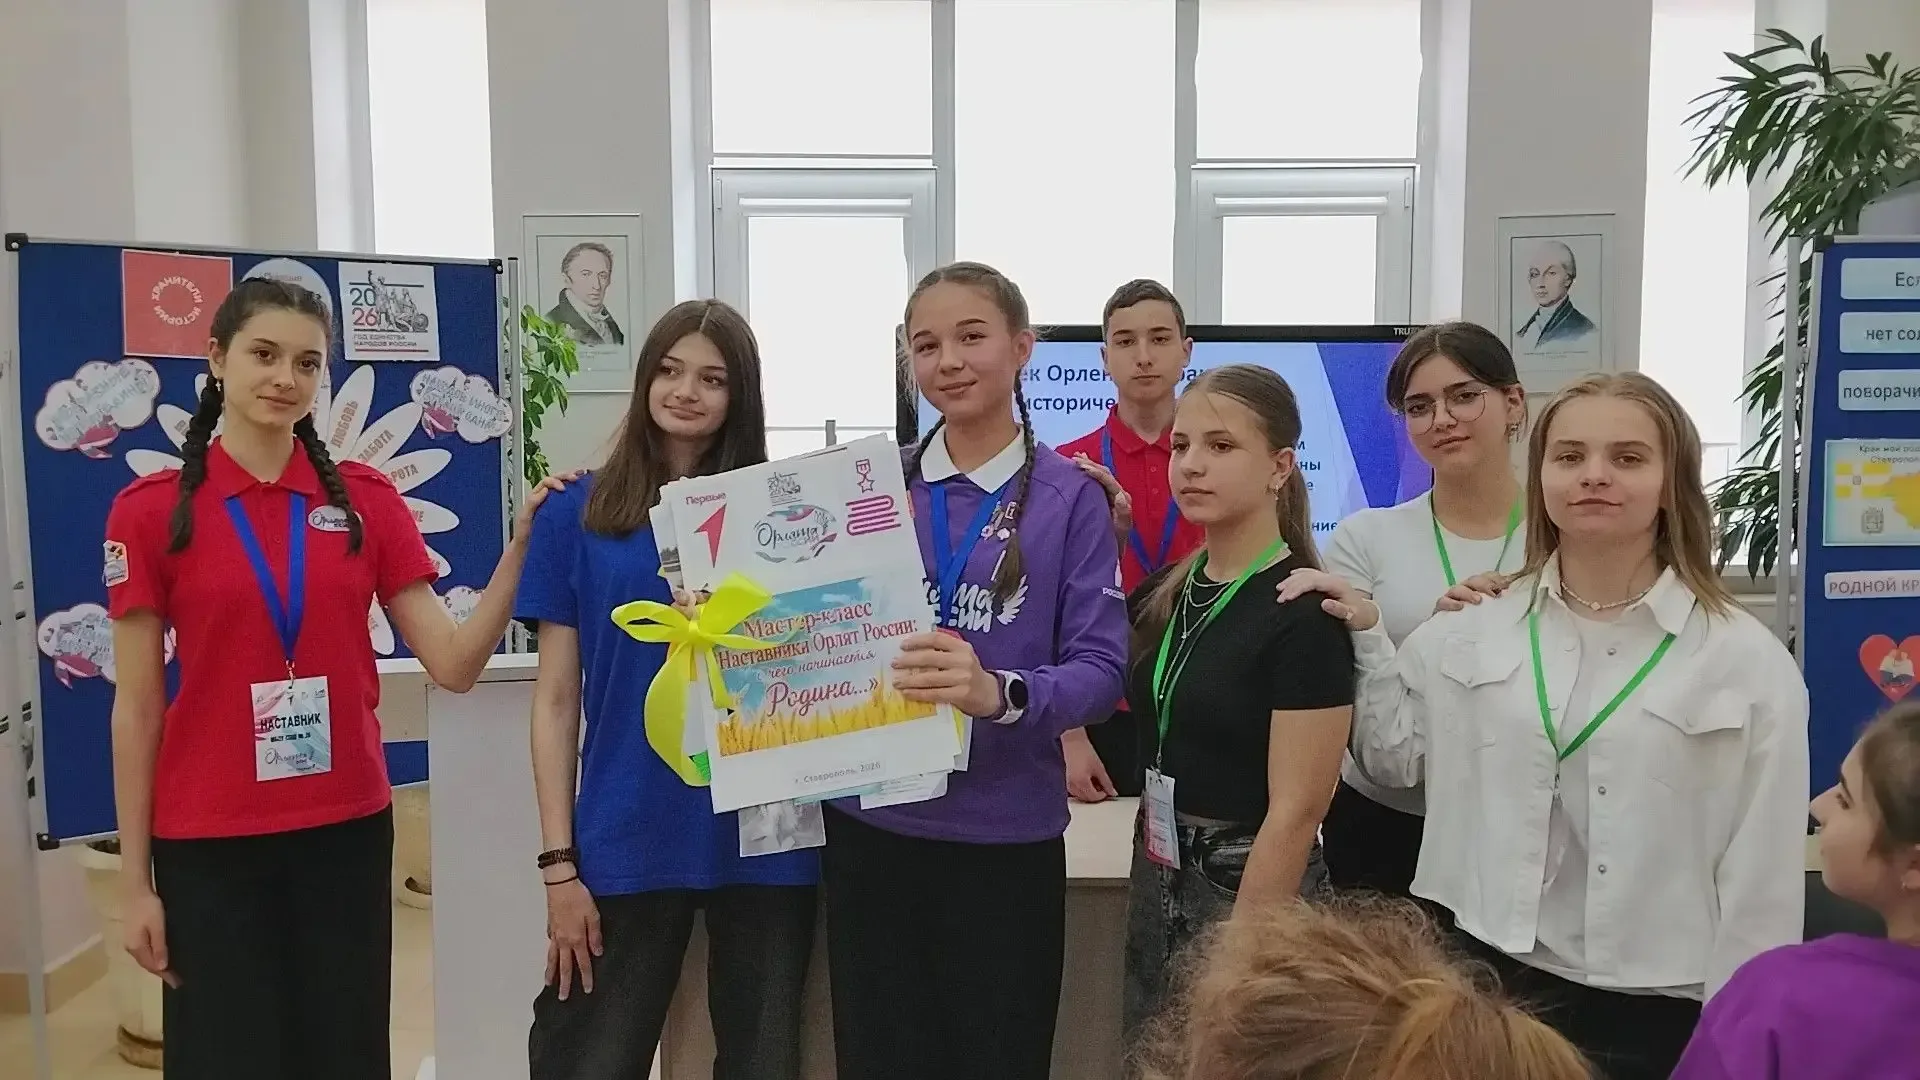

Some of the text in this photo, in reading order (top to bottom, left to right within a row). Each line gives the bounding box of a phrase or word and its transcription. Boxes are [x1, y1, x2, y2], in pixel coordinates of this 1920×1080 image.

[152, 276, 203, 303] ХРАНИТЕЛИ
[350, 287, 376, 306] 20
[153, 305, 202, 326] ИСТОРИИ
[352, 307, 377, 326] 26
[1866, 329, 1893, 341] нет
[331, 400, 359, 449] ЛЮБОВЬ
[358, 429, 395, 464] ЗАБОТА
[1829, 576, 1897, 595] РОДНОЙ
[743, 601, 874, 640] Мастер-класс
[718, 617, 919, 671] Наставники Орлят России:
[798, 649, 877, 674] начинается
[260, 712, 322, 731] НАСТАВНИК
